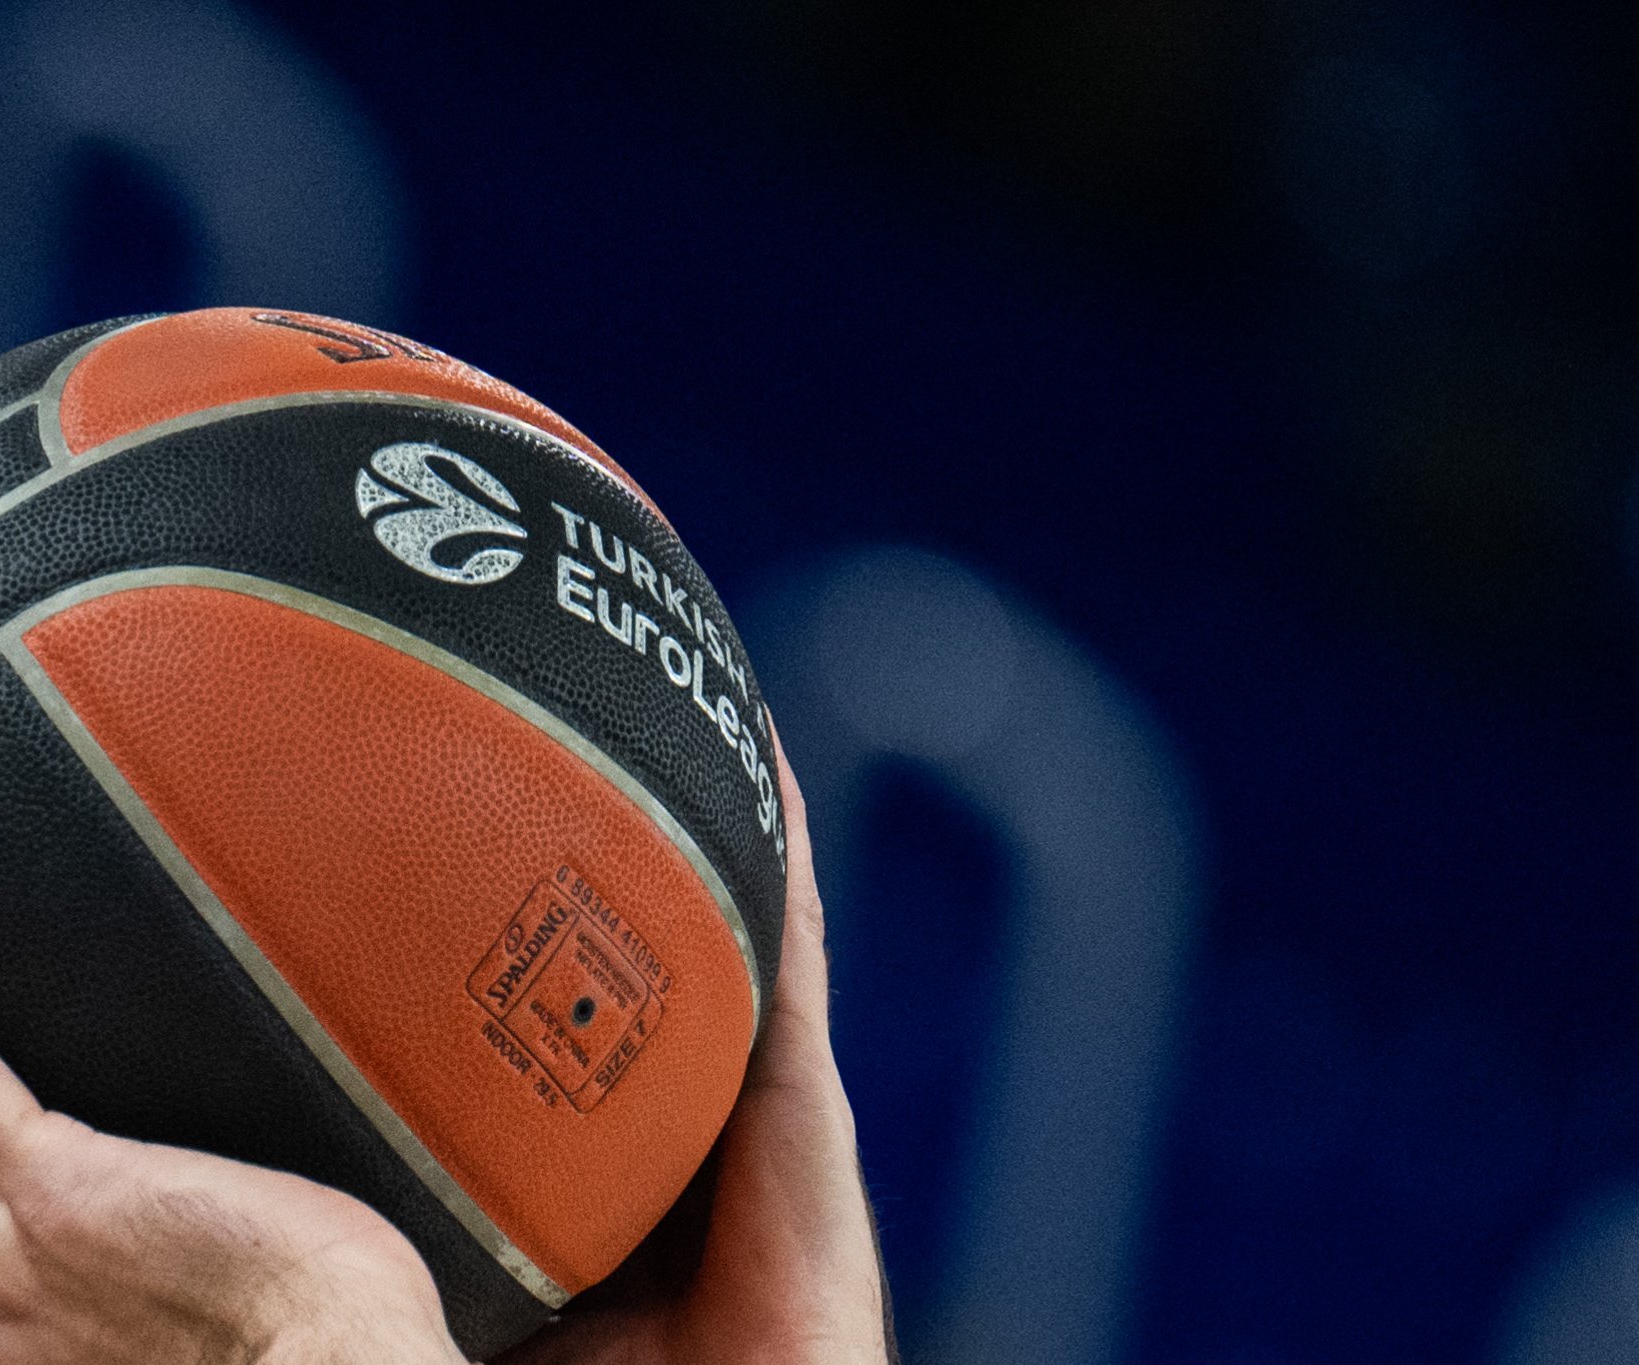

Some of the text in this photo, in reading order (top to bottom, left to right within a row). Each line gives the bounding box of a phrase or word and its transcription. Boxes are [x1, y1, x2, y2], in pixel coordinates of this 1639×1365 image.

[551, 501, 749, 705] TURKISH
[486, 901, 568, 1008] SPALDING
[481, 1021, 531, 1076] INDOOR
[595, 1018, 647, 1089] SIZE 7
